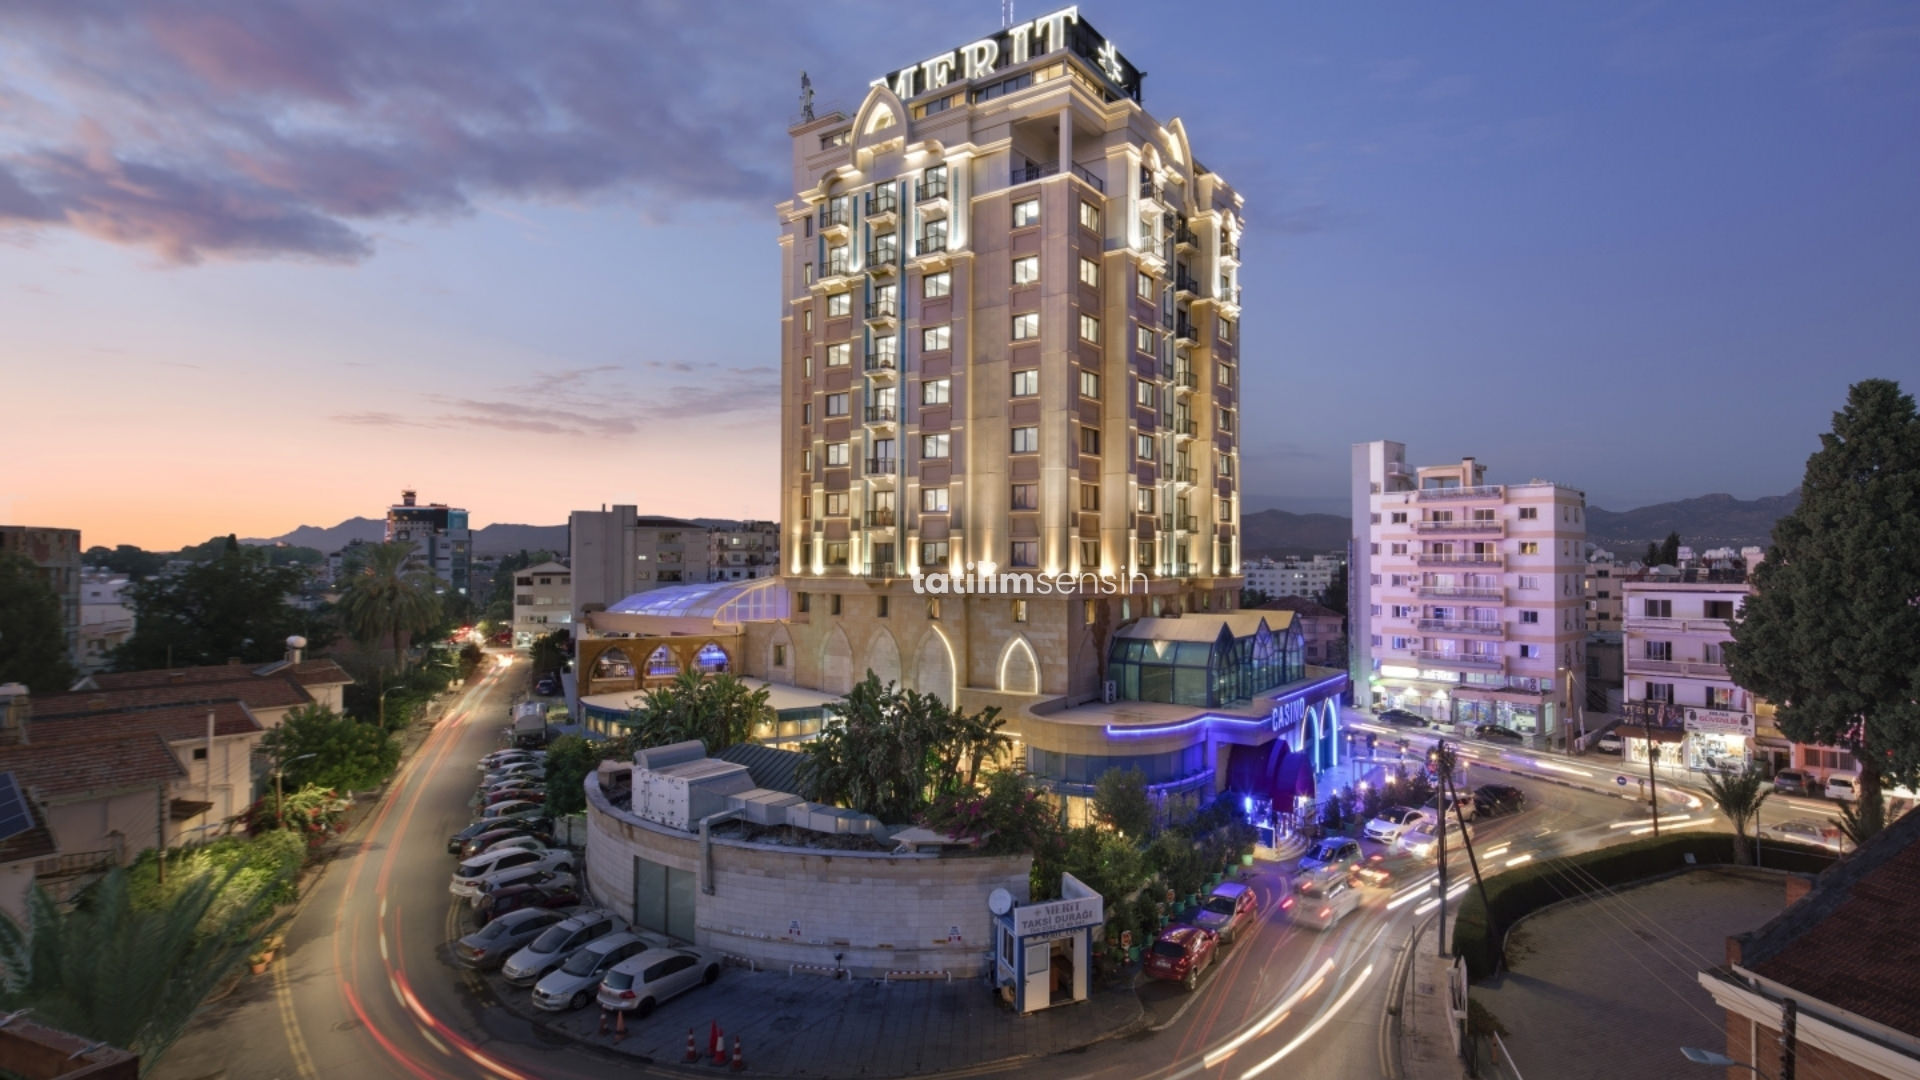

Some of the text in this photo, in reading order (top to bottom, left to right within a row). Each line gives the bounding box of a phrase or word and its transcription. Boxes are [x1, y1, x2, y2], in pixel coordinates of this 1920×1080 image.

[869, 5, 1079, 101] MERIT
[1272, 697, 1305, 732] CASINO
[1056, 910, 1093, 923] DURAĞI
